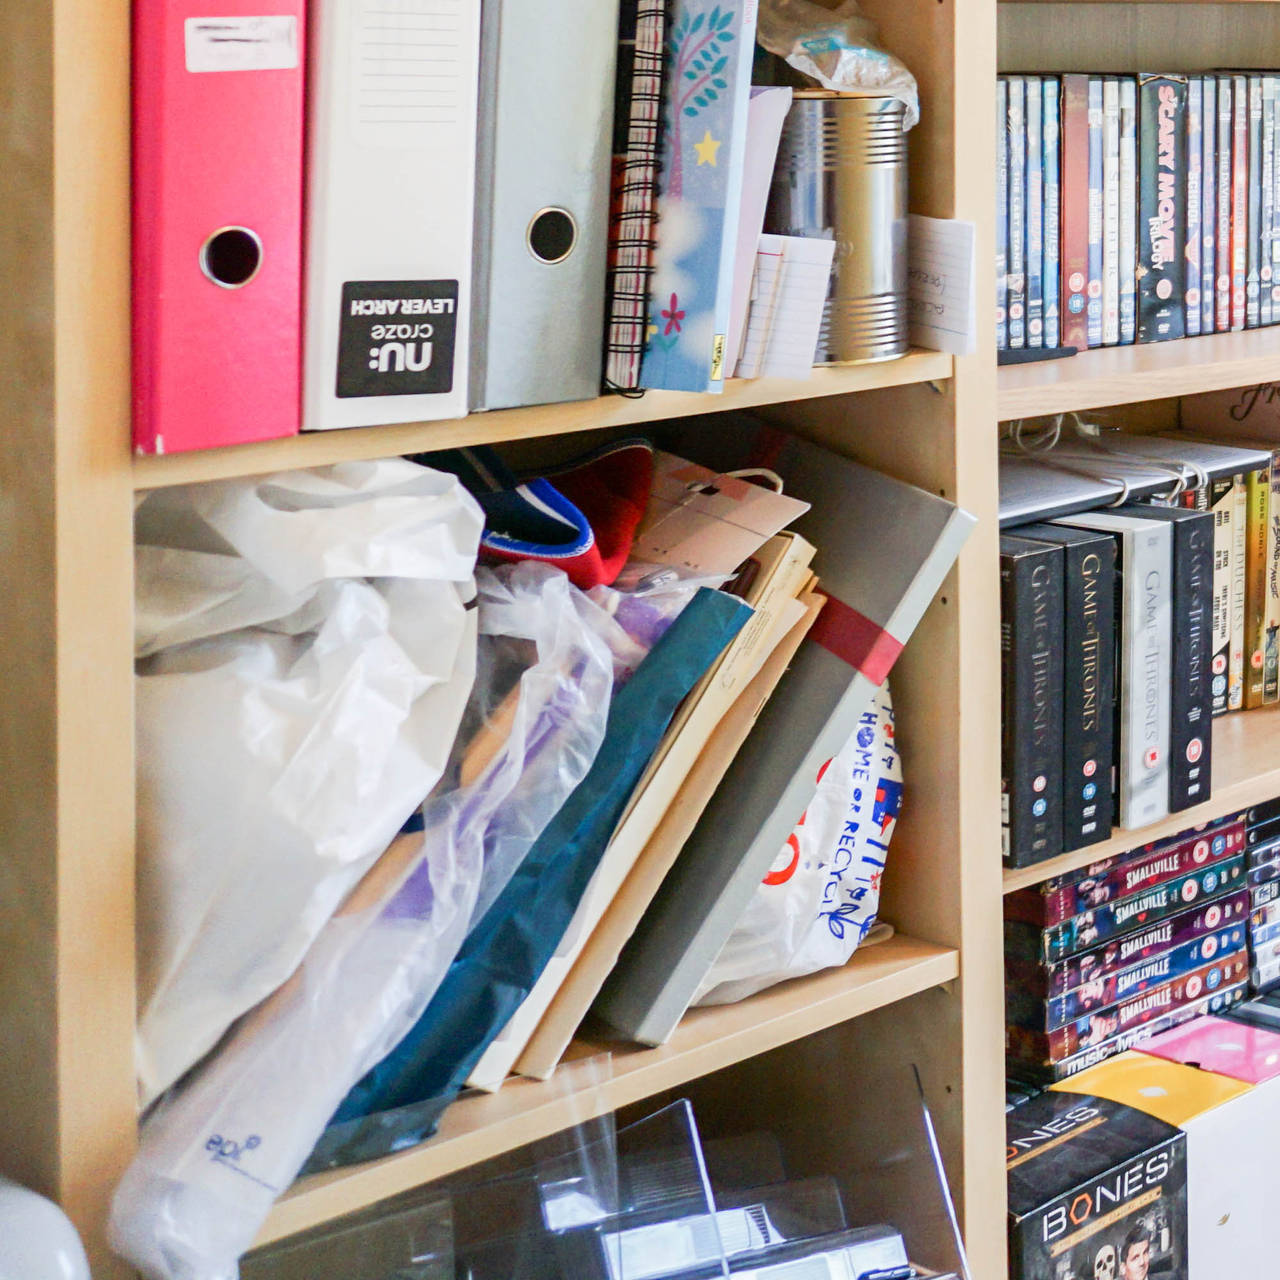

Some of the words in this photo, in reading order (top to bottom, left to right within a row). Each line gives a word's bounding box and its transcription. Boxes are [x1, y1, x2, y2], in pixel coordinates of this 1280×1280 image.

[1157, 84, 1176, 171] SCARY
[1157, 172, 1175, 264] MOVIE
[1148, 216, 1165, 271] TRILOGY
[350, 299, 400, 316] ARCH
[401, 298, 454, 315] LEVER
[370, 323, 434, 340] craze
[368, 341, 433, 373] nu:
[1081, 554, 1101, 619] GAME
[1144, 570, 1161, 631] GAME
[1270, 567, 1279, 600] MUSIC
[1081, 632, 1100, 732] THRONES
[1144, 651, 1160, 742] THRONES
[853, 712, 878, 782] HOME
[1126, 853, 1180, 890] SMALLVILLE
[1115, 889, 1168, 926] SMALLVILLE
[1120, 925, 1173, 961] SMALLVILLE
[1117, 957, 1171, 994] SMALLVILLE
[1120, 988, 1172, 1025] SMALLVILLE
[1067, 1048, 1109, 1076] music
[1042, 1152, 1169, 1243] BONES
